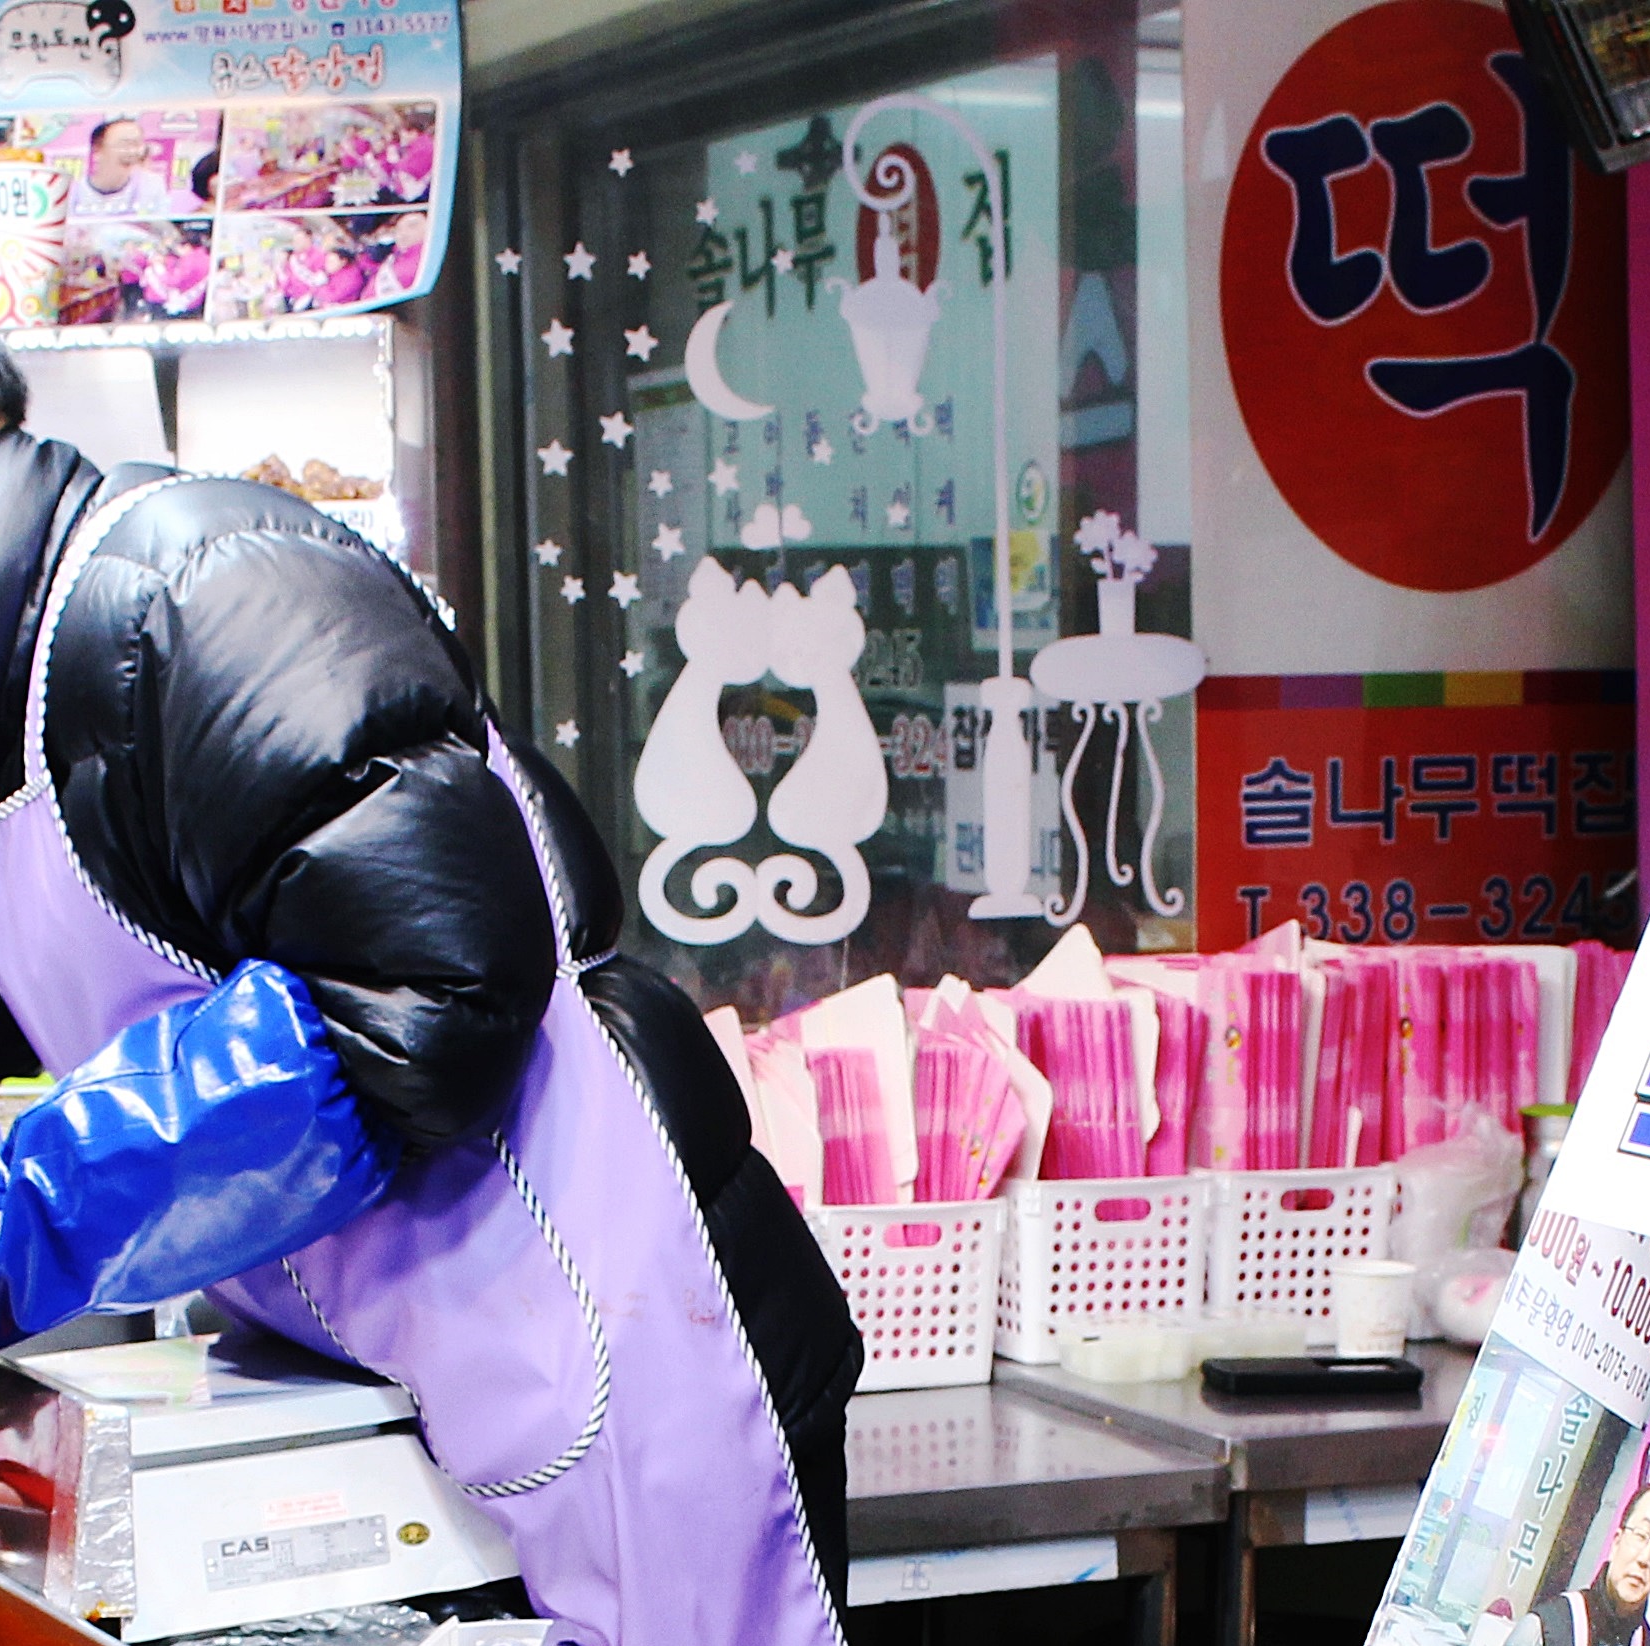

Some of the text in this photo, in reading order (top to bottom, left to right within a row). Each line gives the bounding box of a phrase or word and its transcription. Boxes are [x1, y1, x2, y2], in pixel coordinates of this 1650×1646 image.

[1260, 48, 1577, 544] 떡
[1241, 750, 1636, 850] 솔나무떡집
[221, 1536, 270, 1558] CAS
